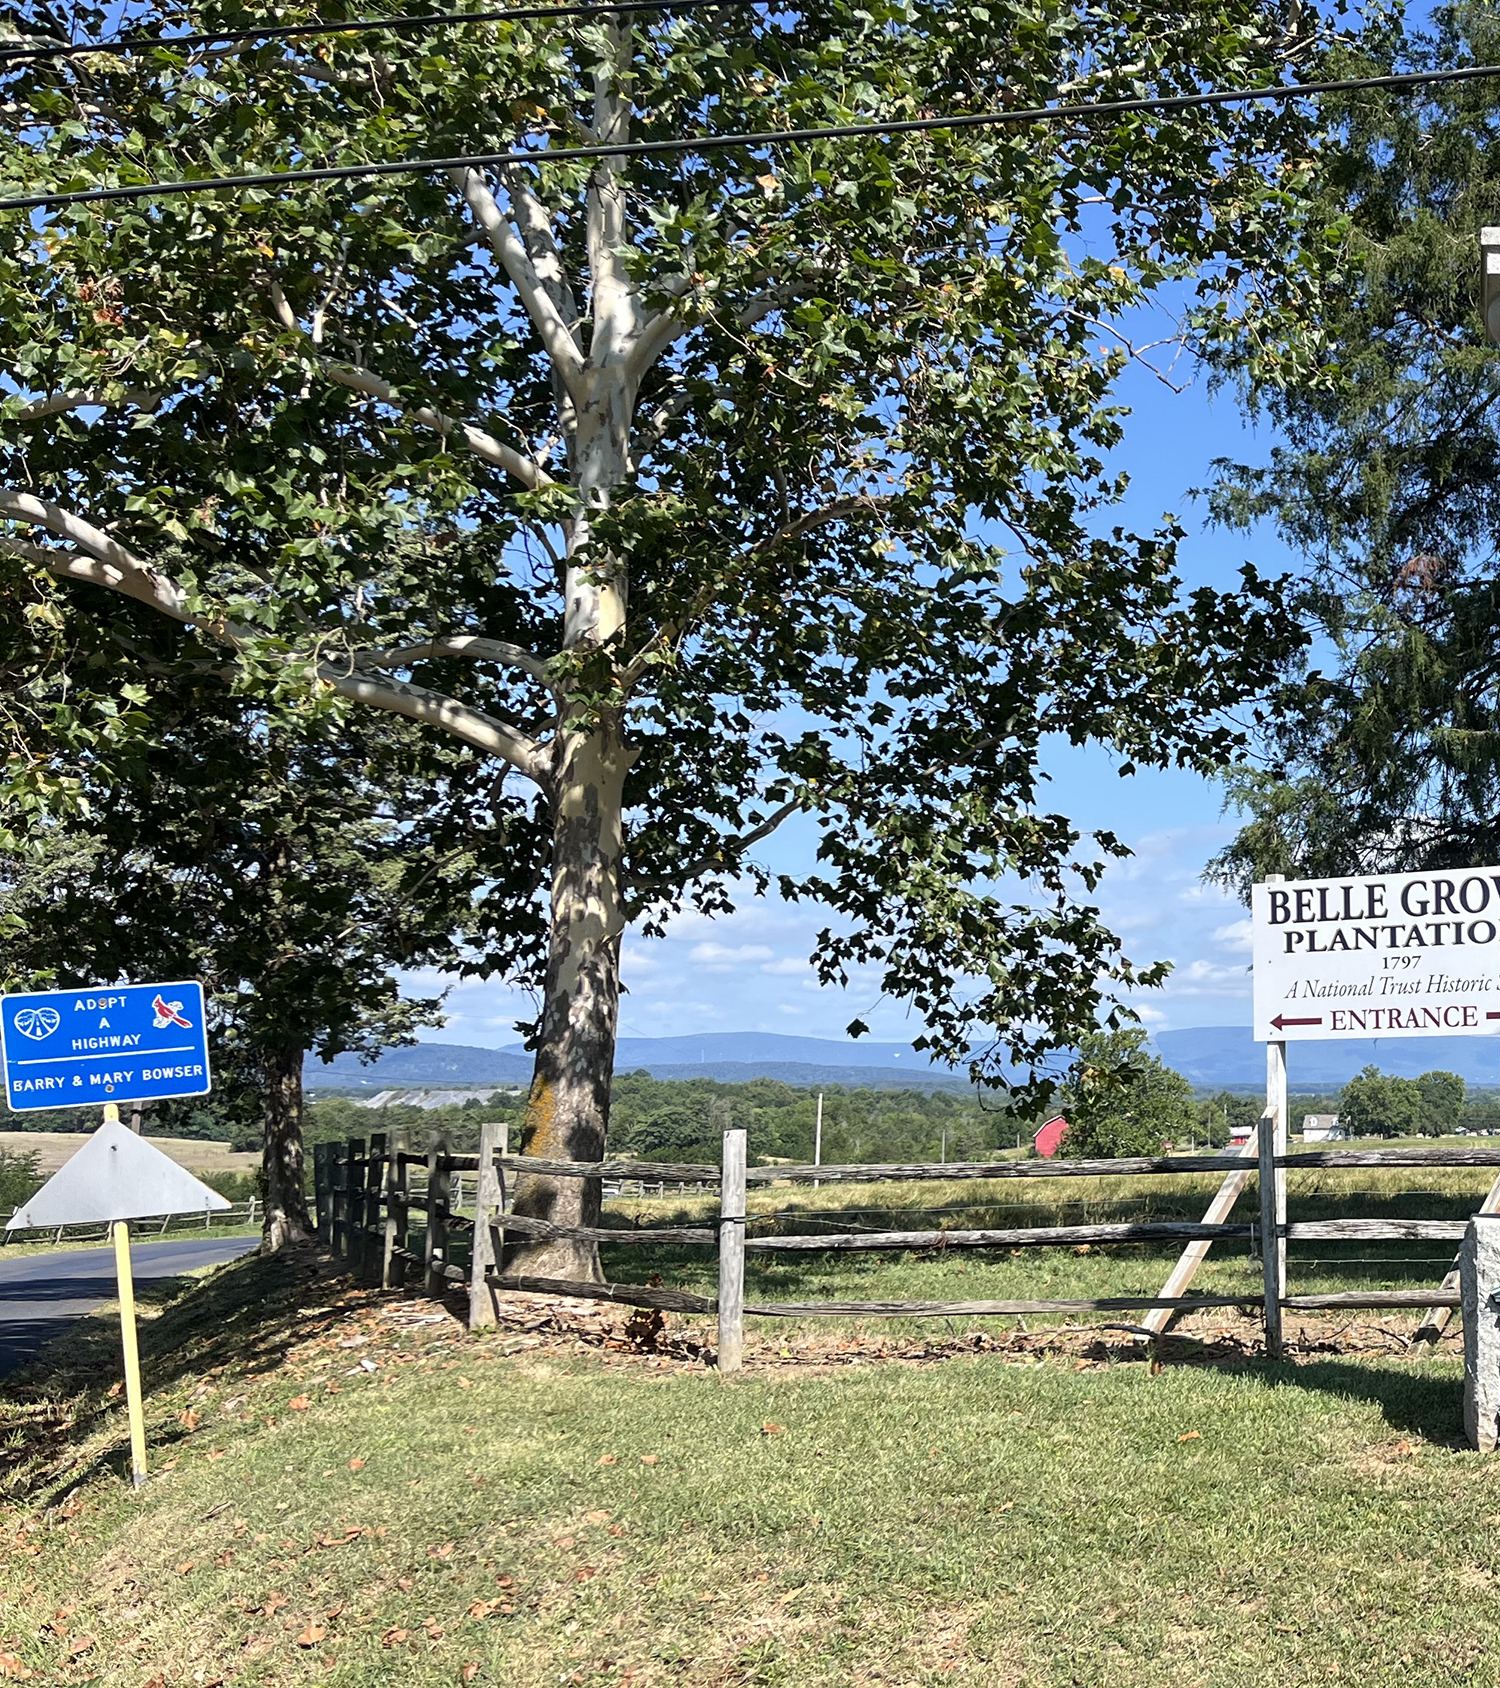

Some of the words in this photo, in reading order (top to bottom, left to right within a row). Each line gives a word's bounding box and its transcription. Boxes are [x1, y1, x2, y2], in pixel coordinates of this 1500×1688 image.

[1267, 882, 1388, 925] BELLE
[1382, 955, 1422, 970] 1797
[1284, 980, 1299, 999] A
[1302, 975, 1375, 999] National
[1379, 975, 1422, 996] Trust
[1425, 973, 1493, 994] Historic
[99, 1017, 111, 1029] A
[1330, 1005, 1479, 1031] ENTRANCE
[72, 1033, 141, 1050] HIGHWAY
[13, 1077, 65, 1092] BARRY
[72, 1075, 83, 1086] &
[89, 1071, 134, 1085] MARY
[142, 1065, 203, 1081] BOWSER
